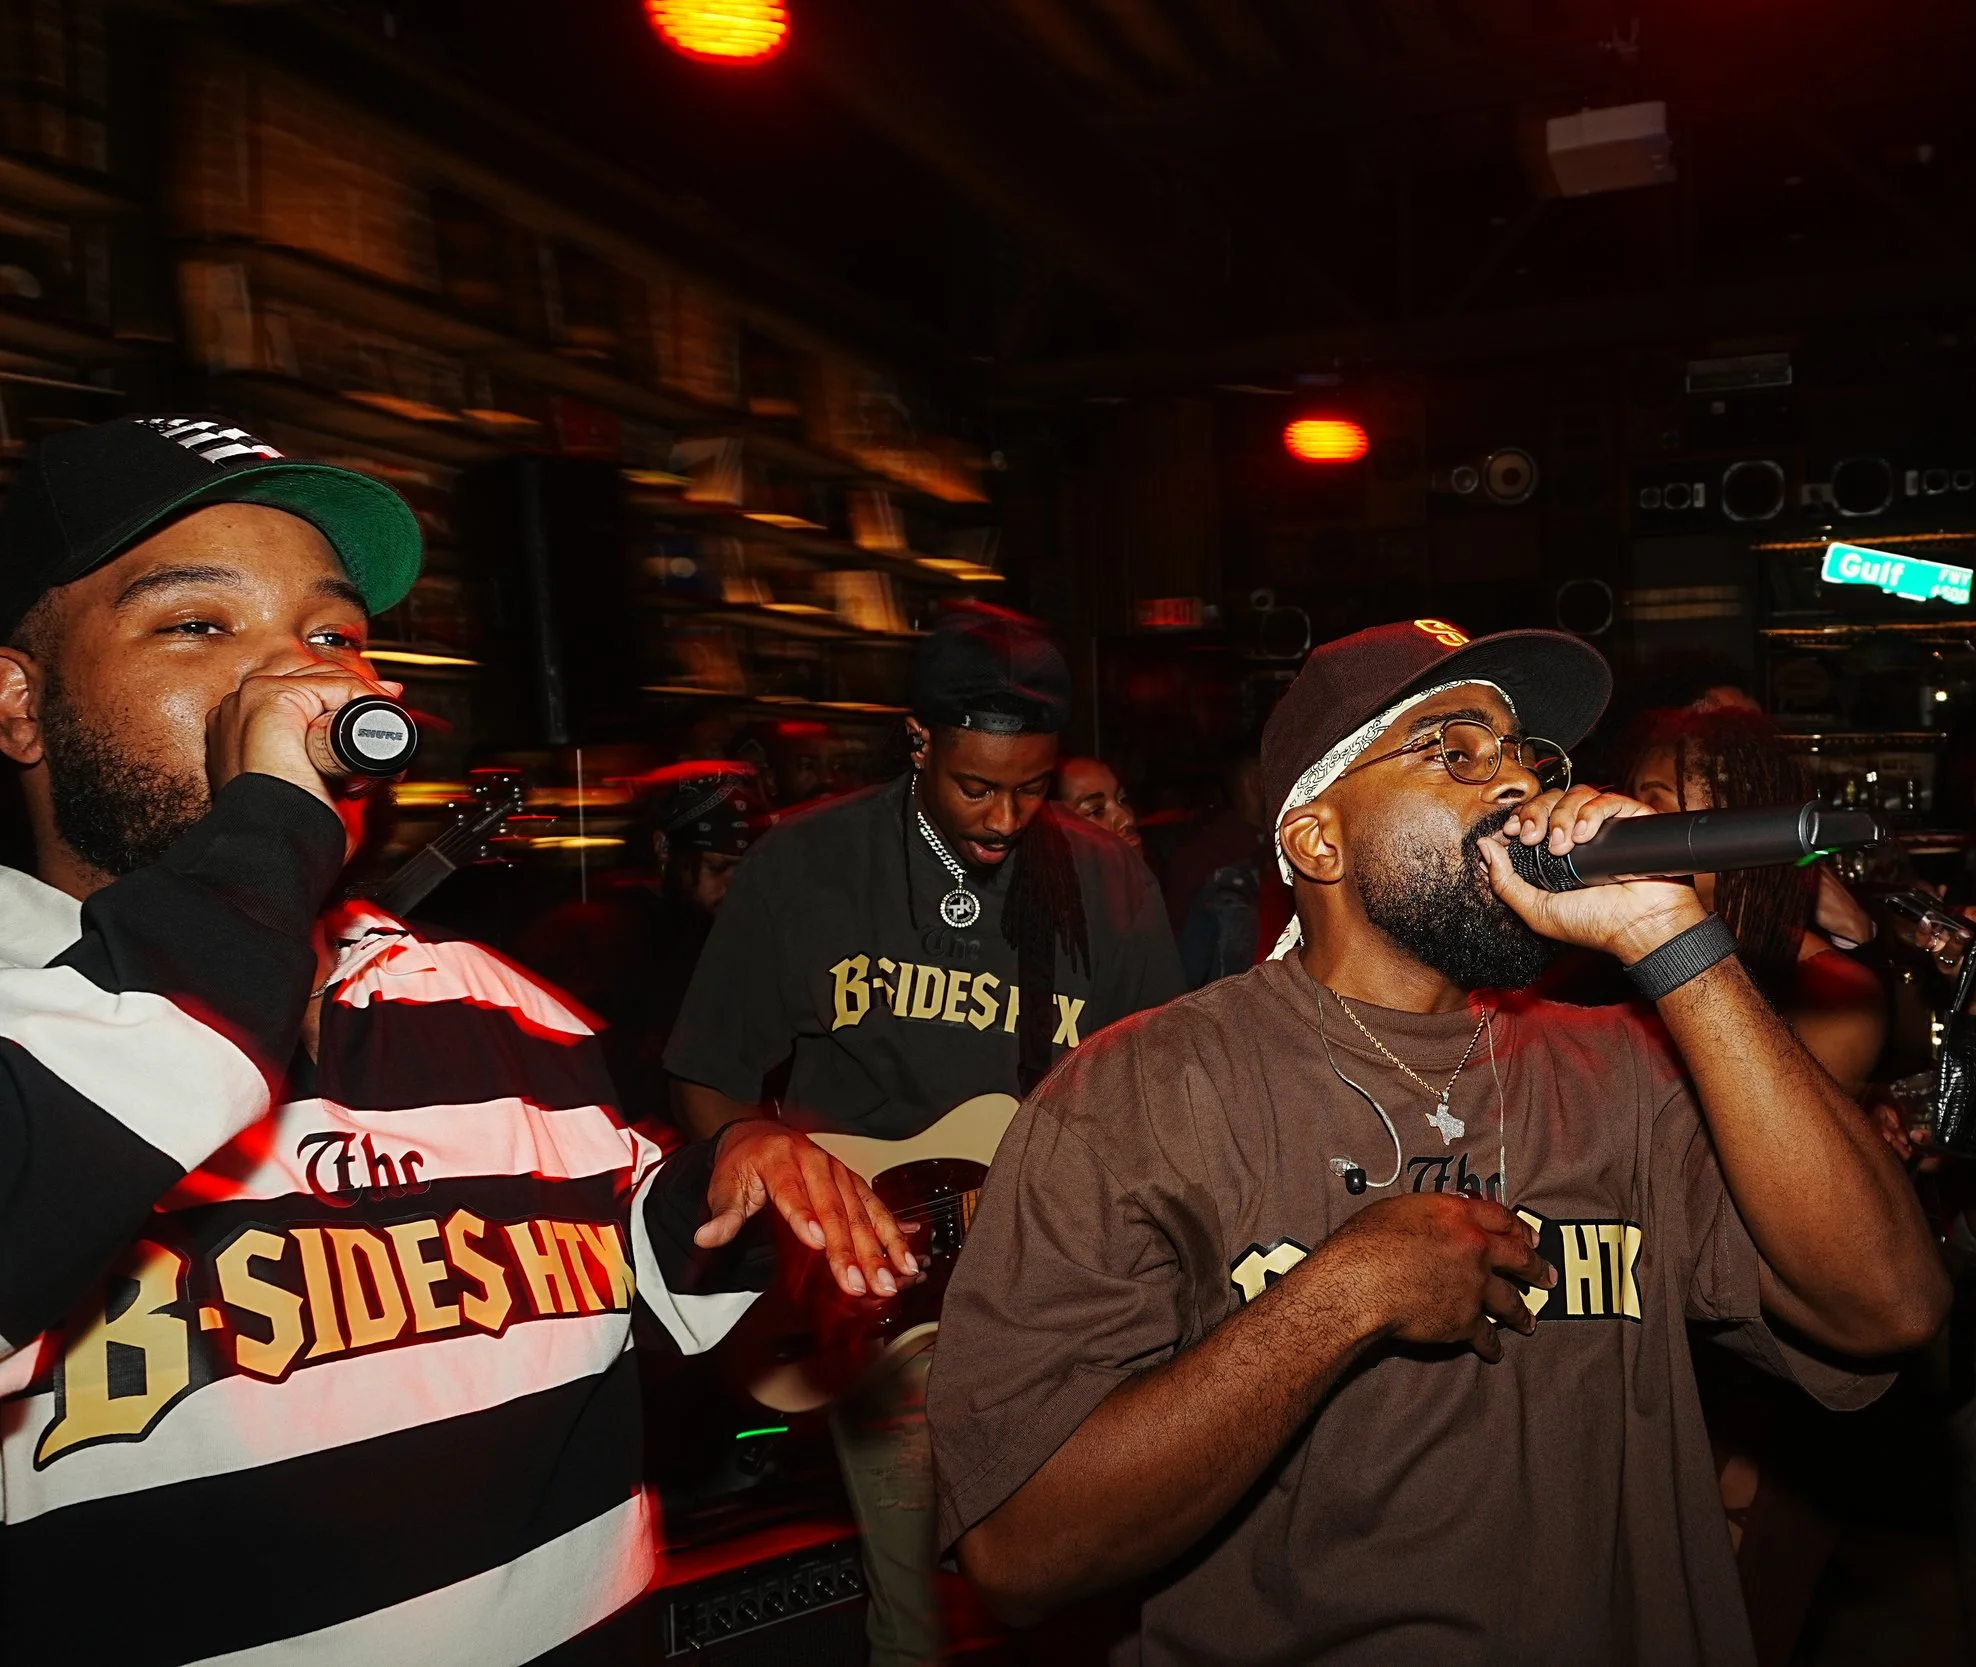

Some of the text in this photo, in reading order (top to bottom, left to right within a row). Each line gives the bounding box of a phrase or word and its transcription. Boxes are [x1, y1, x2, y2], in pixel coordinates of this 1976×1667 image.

[1839, 553, 1905, 587] Gulf
[357, 728, 404, 741] SHURE
[503, 1219, 637, 1315] HTX
[1559, 1224, 1642, 1320] HTX
